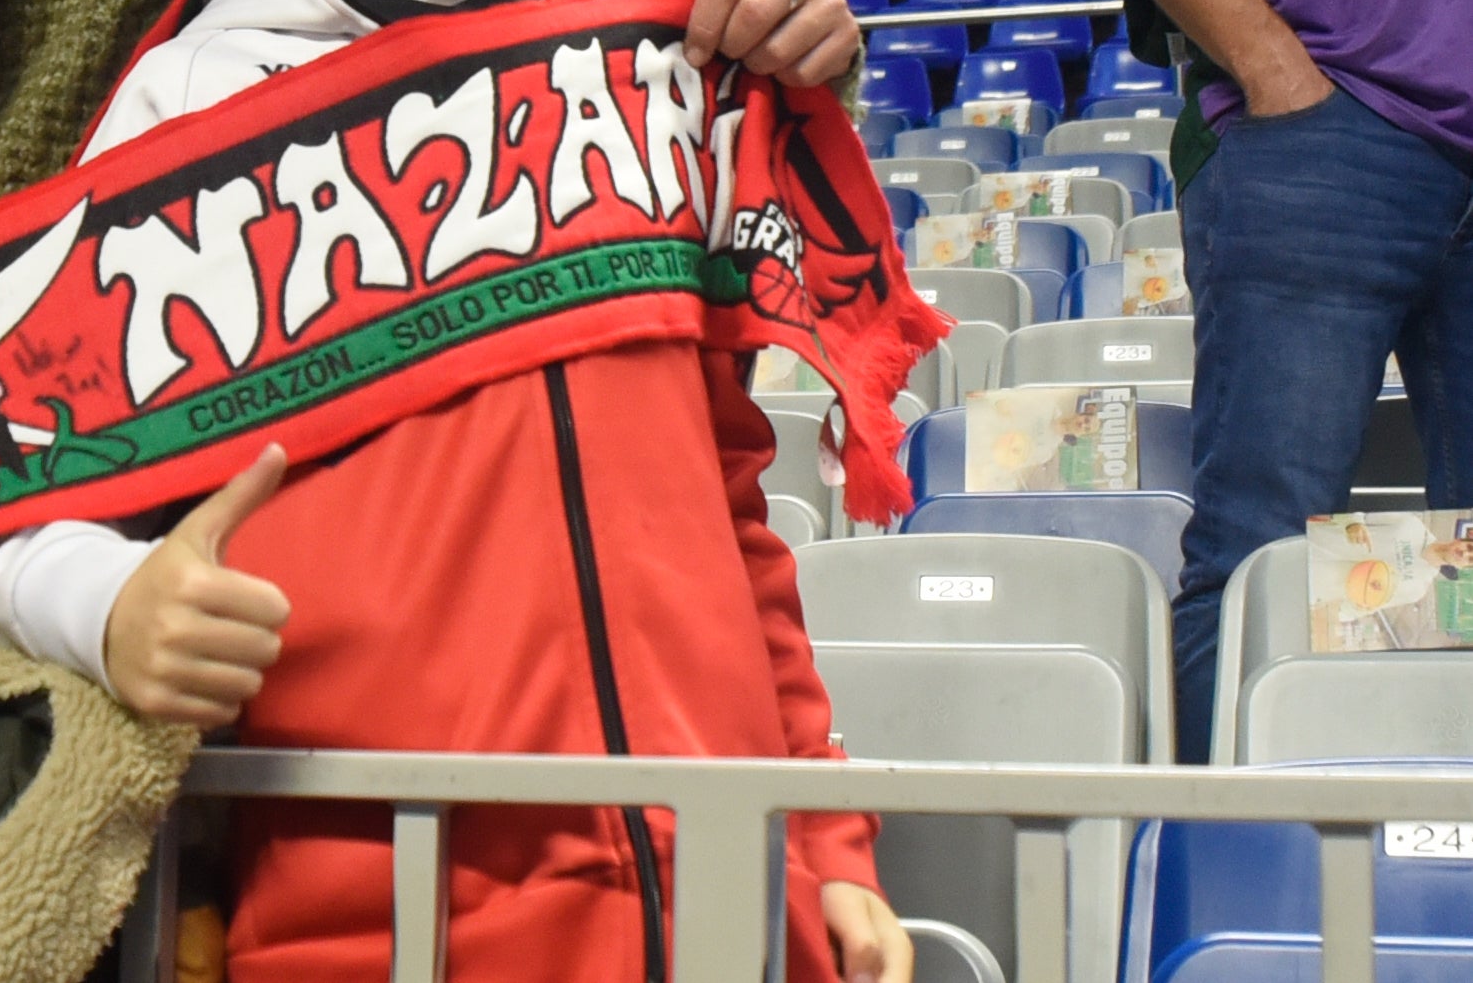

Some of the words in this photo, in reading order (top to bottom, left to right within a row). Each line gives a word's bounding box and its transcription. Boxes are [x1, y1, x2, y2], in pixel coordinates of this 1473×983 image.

[392, 295, 486, 350] SOLO
[491, 270, 563, 313] POR
[609, 249, 657, 281] POR
[939, 580, 974, 599] 23
[1413, 824, 1466, 853] 24
